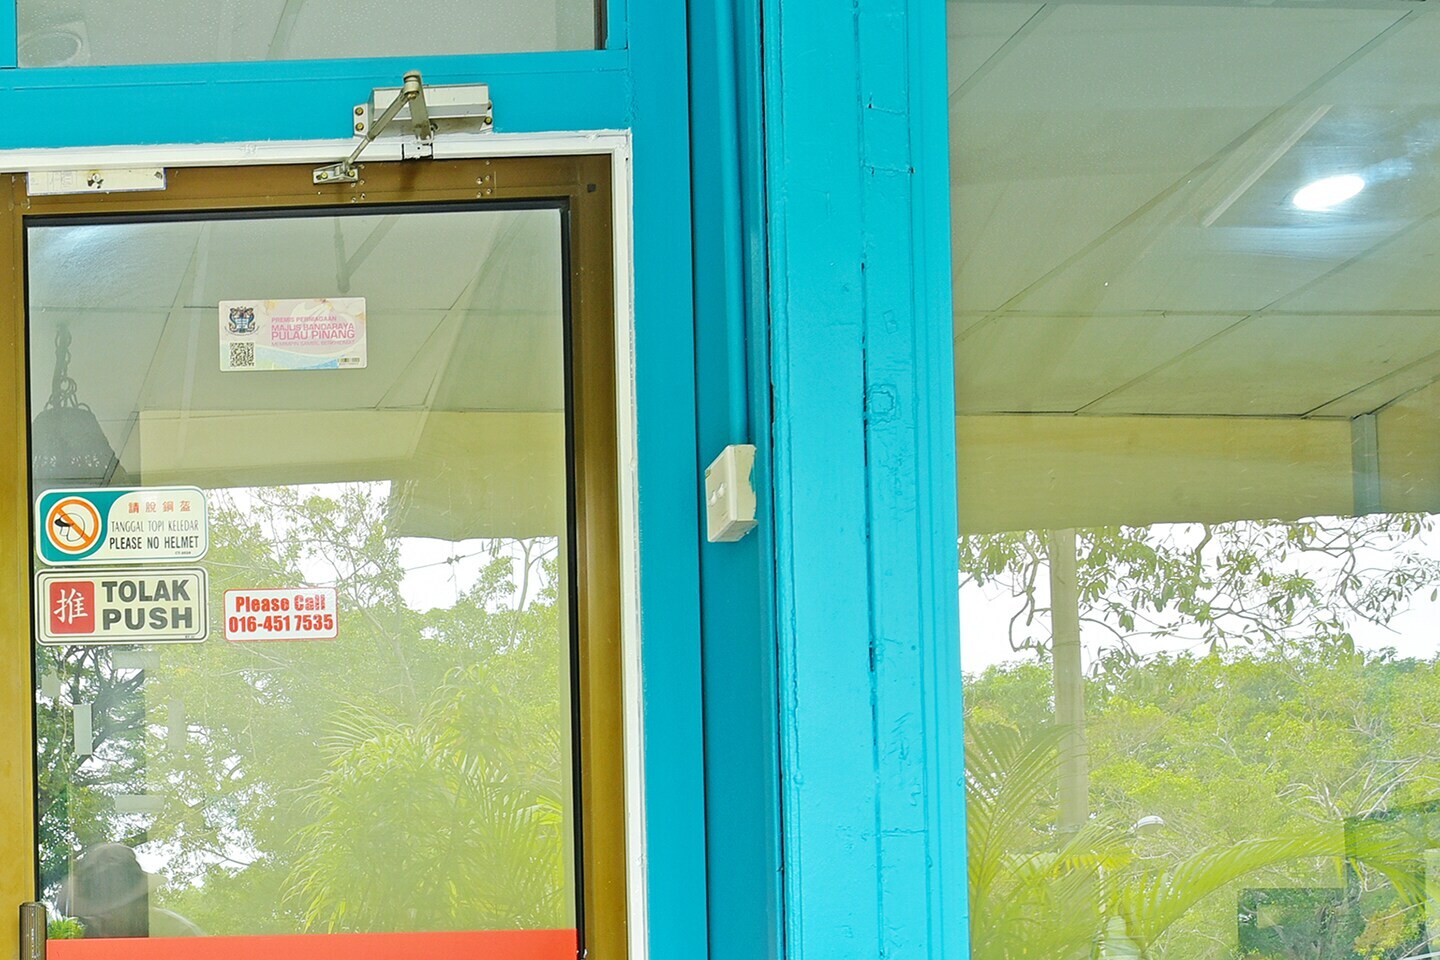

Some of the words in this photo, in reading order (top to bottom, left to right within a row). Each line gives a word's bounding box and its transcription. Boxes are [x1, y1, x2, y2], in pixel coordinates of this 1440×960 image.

[271, 324, 302, 332] MAJLIS
[303, 323, 354, 331] BANDARAYA
[271, 331, 309, 341] PULAU
[311, 330, 356, 340] PINANG
[111, 520, 144, 532] TANGGAL
[148, 520, 164, 532] TOPI
[168, 519, 199, 532] KELEDAR
[109, 537, 142, 549] PLEASE
[147, 536, 160, 549] NO
[164, 535, 199, 549] HELMET
[101, 579, 191, 603] TOLAK
[53, 587, 89, 625] 推
[235, 596, 290, 612] Please
[294, 594, 326, 611] Call
[102, 607, 193, 631] PUSH
[228, 615, 290, 633] 016-451
[294, 614, 334, 631] 7535
